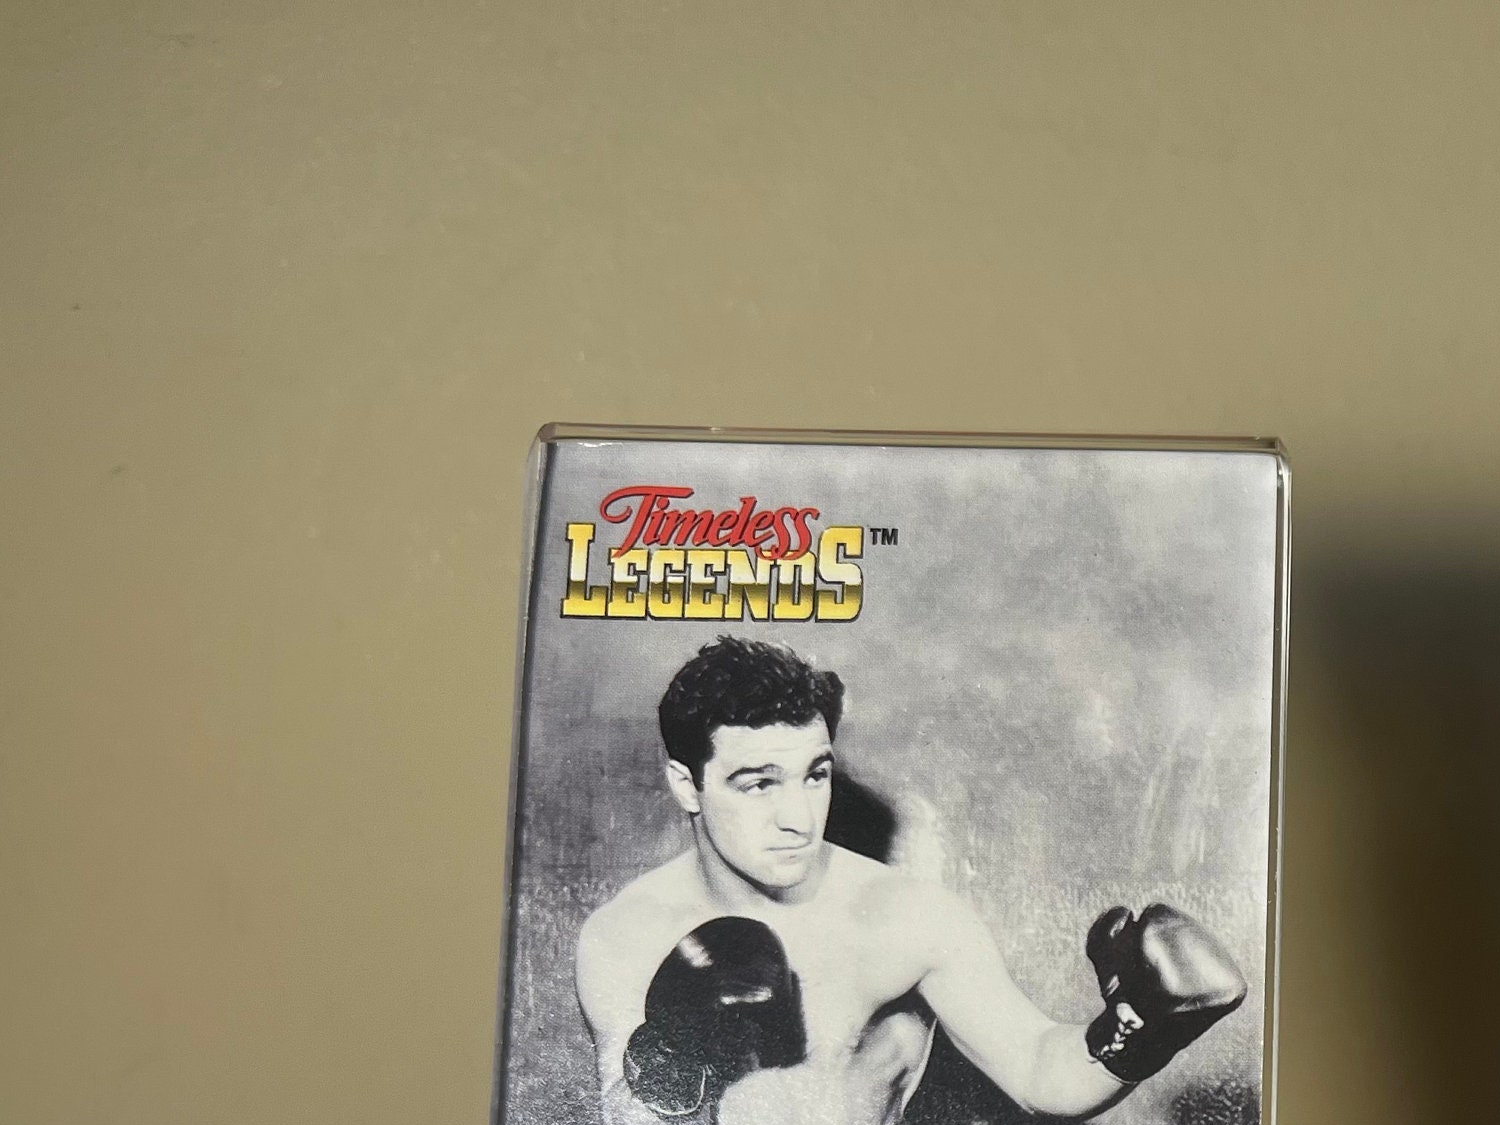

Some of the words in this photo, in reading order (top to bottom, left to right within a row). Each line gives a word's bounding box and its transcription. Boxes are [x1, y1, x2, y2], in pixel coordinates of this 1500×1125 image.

[599, 485, 820, 561] Timeless
[560, 522, 865, 623] LEGENDS
[870, 527, 898, 546] TM
